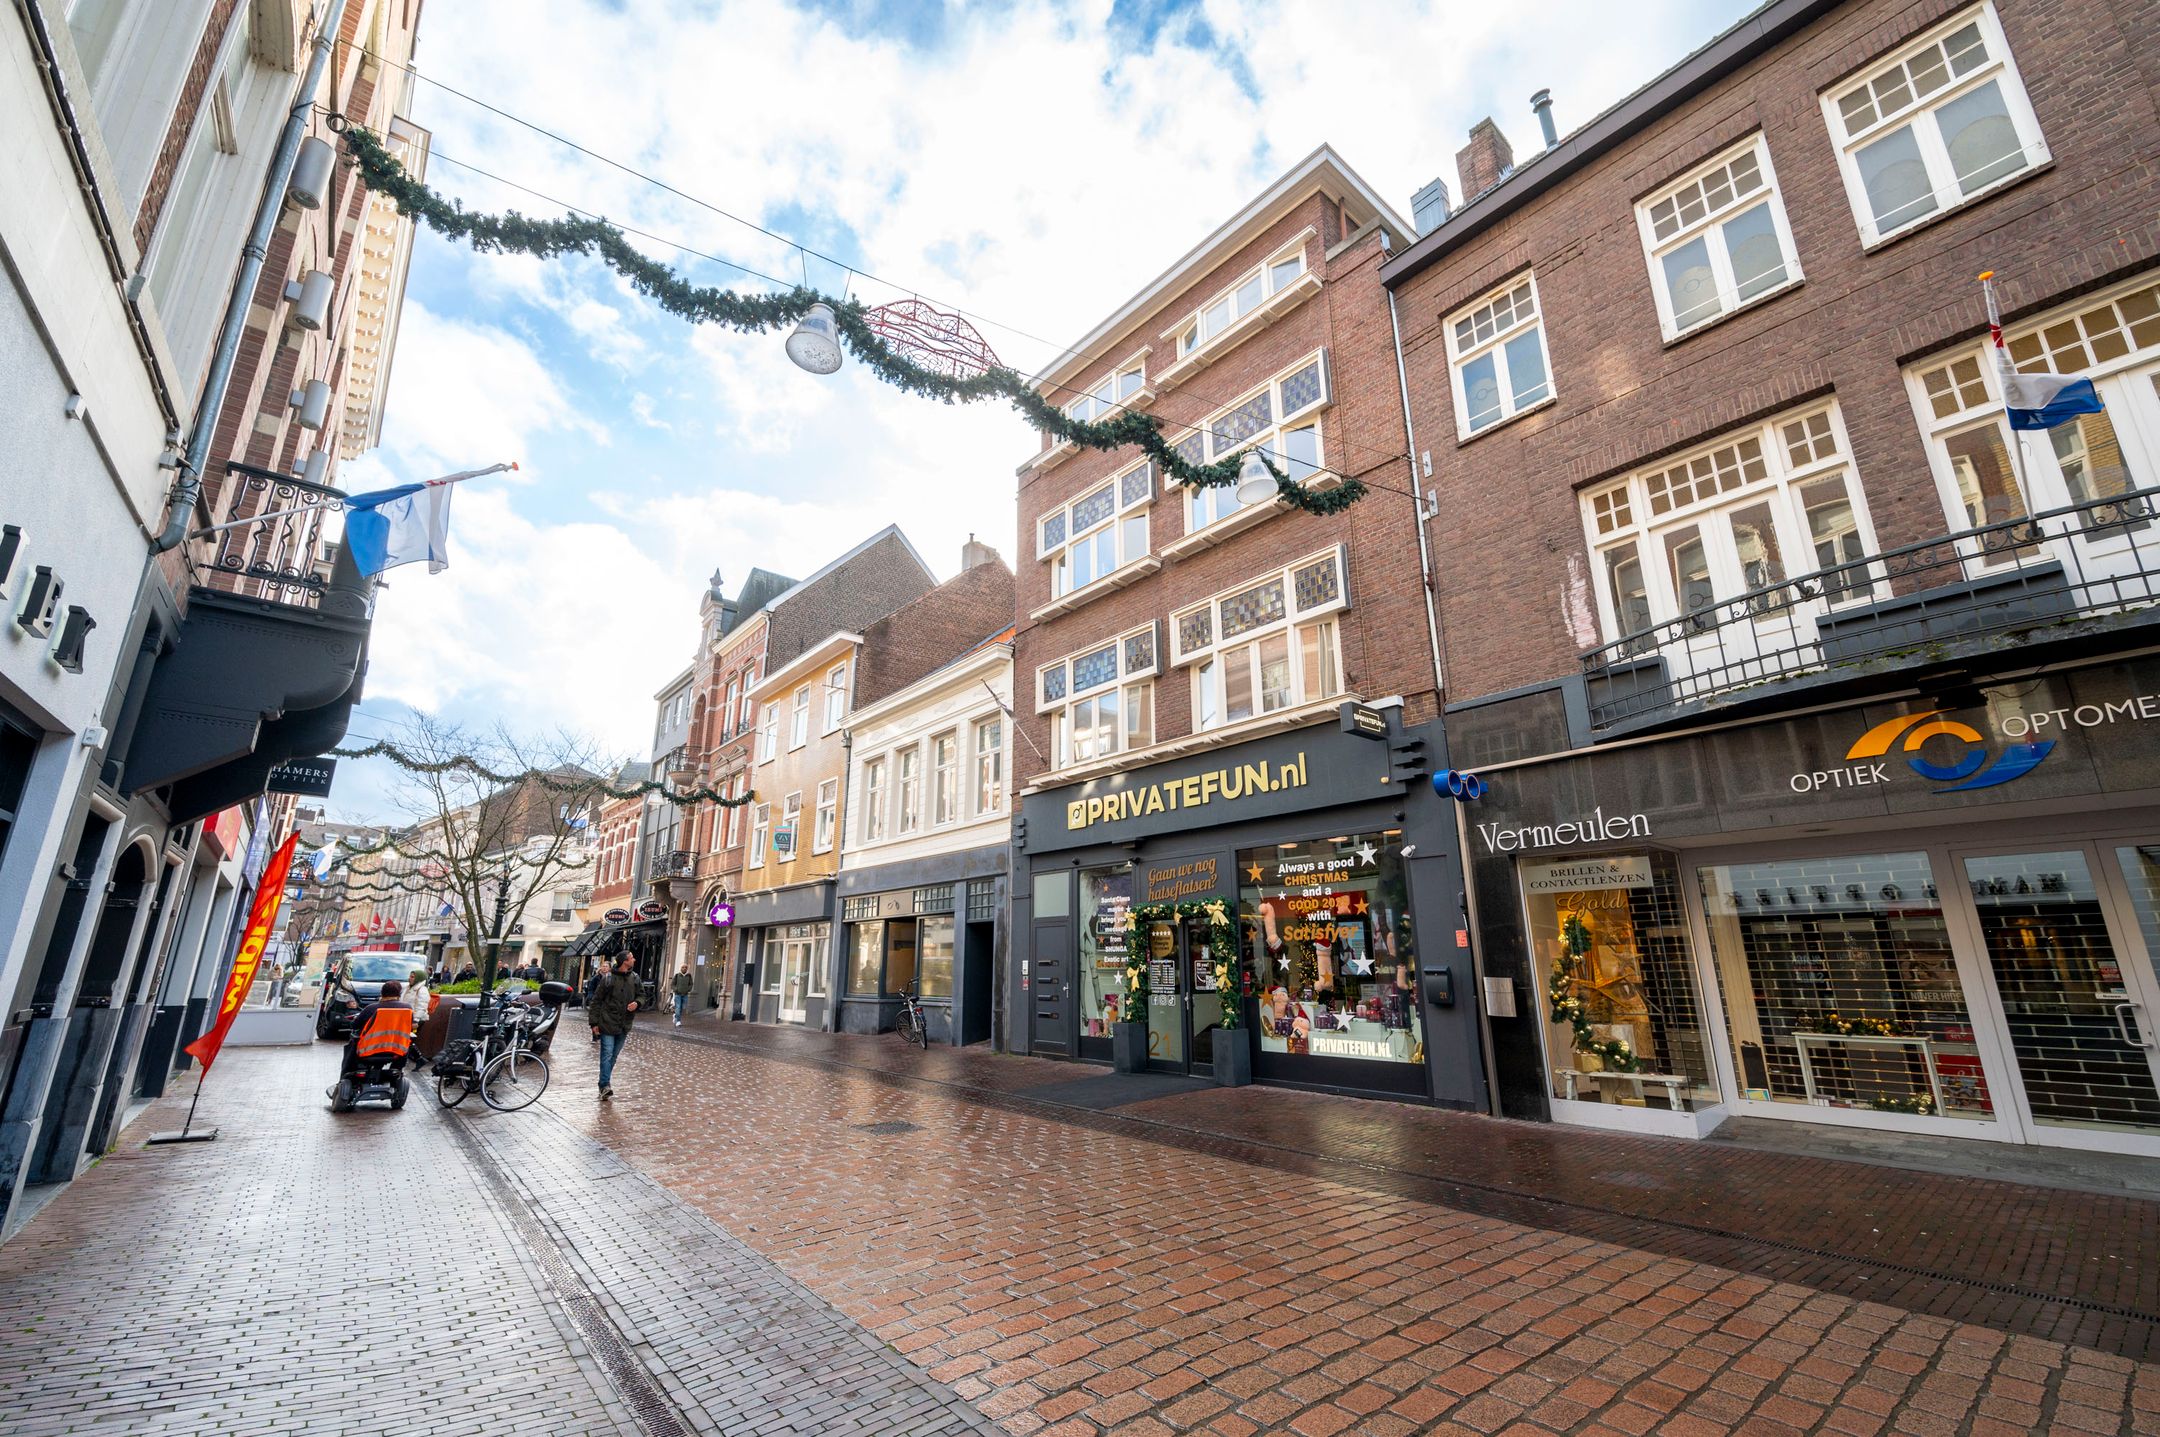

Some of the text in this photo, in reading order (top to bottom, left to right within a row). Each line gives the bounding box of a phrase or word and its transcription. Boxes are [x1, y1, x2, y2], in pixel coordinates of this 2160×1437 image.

[2001, 694, 2160, 738] OPTOME
[271, 765, 329, 778] HAMERS
[271, 773, 326, 785] OPTIEK
[1790, 763, 1890, 793] OPTIEK
[1088, 752, 1307, 825] PRIVATEFUN.nl
[1477, 806, 1653, 854] Vermeulen
[1148, 858, 1216, 886] Gaan we nog
[1278, 856, 1354, 875] Always a good
[1550, 865, 1620, 878] BRILLEN &
[1148, 874, 1218, 902] hatseflatsen?
[1284, 871, 1349, 886] CHRISTMAS
[1530, 873, 1646, 889] CONTACTLENZEN
[1303, 887, 1332, 897] and a
[1288, 897, 1319, 910] GOOD
[1556, 888, 1625, 918] Gold
[1307, 910, 1331, 921] with
[1283, 922, 1359, 942] Satisfyer
[1149, 1031, 1171, 1057] 21
[1313, 1038, 1392, 1058] PRIVATEFUN.NL
